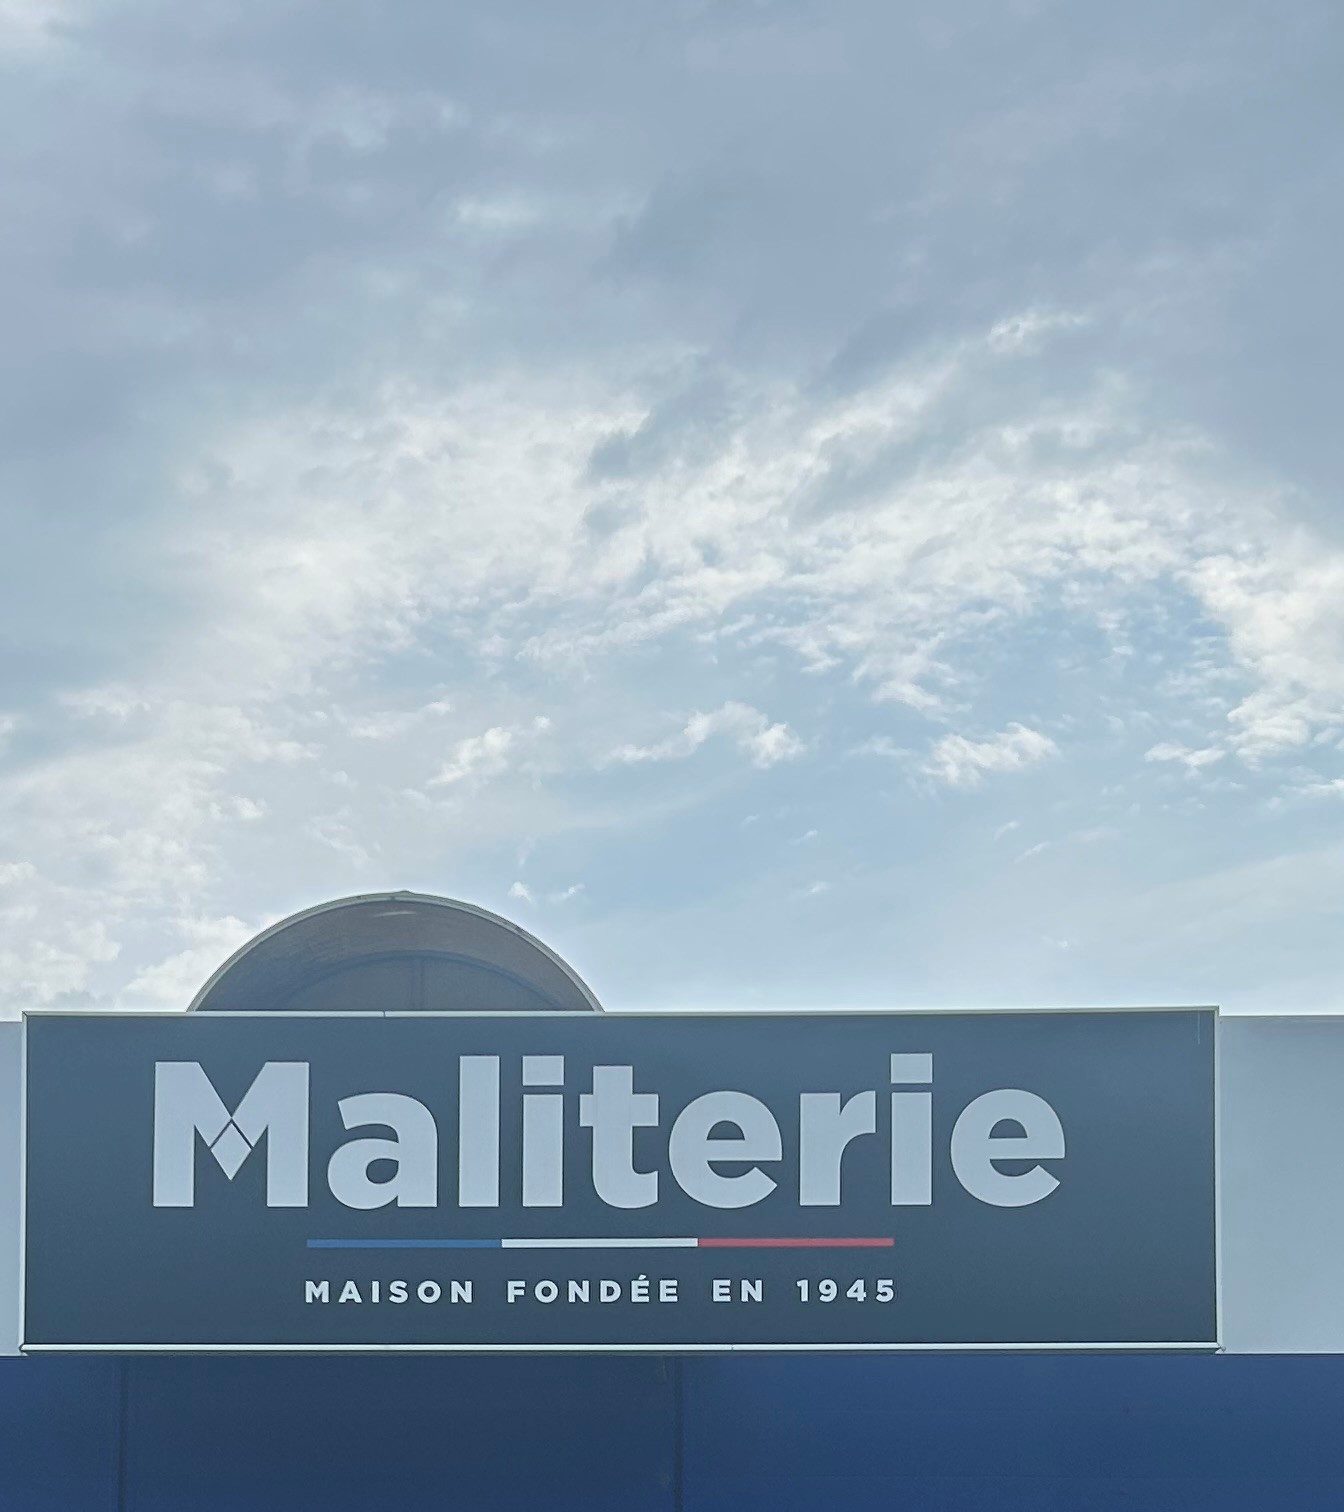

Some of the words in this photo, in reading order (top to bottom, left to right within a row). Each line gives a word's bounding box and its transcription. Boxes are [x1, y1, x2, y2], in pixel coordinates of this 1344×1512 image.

[152, 1053, 1067, 1210] Maliterie
[304, 1280, 475, 1304] MAISON
[506, 1274, 681, 1304] FONDÉE
[711, 1279, 765, 1302] EN
[795, 1279, 897, 1303] 1945
